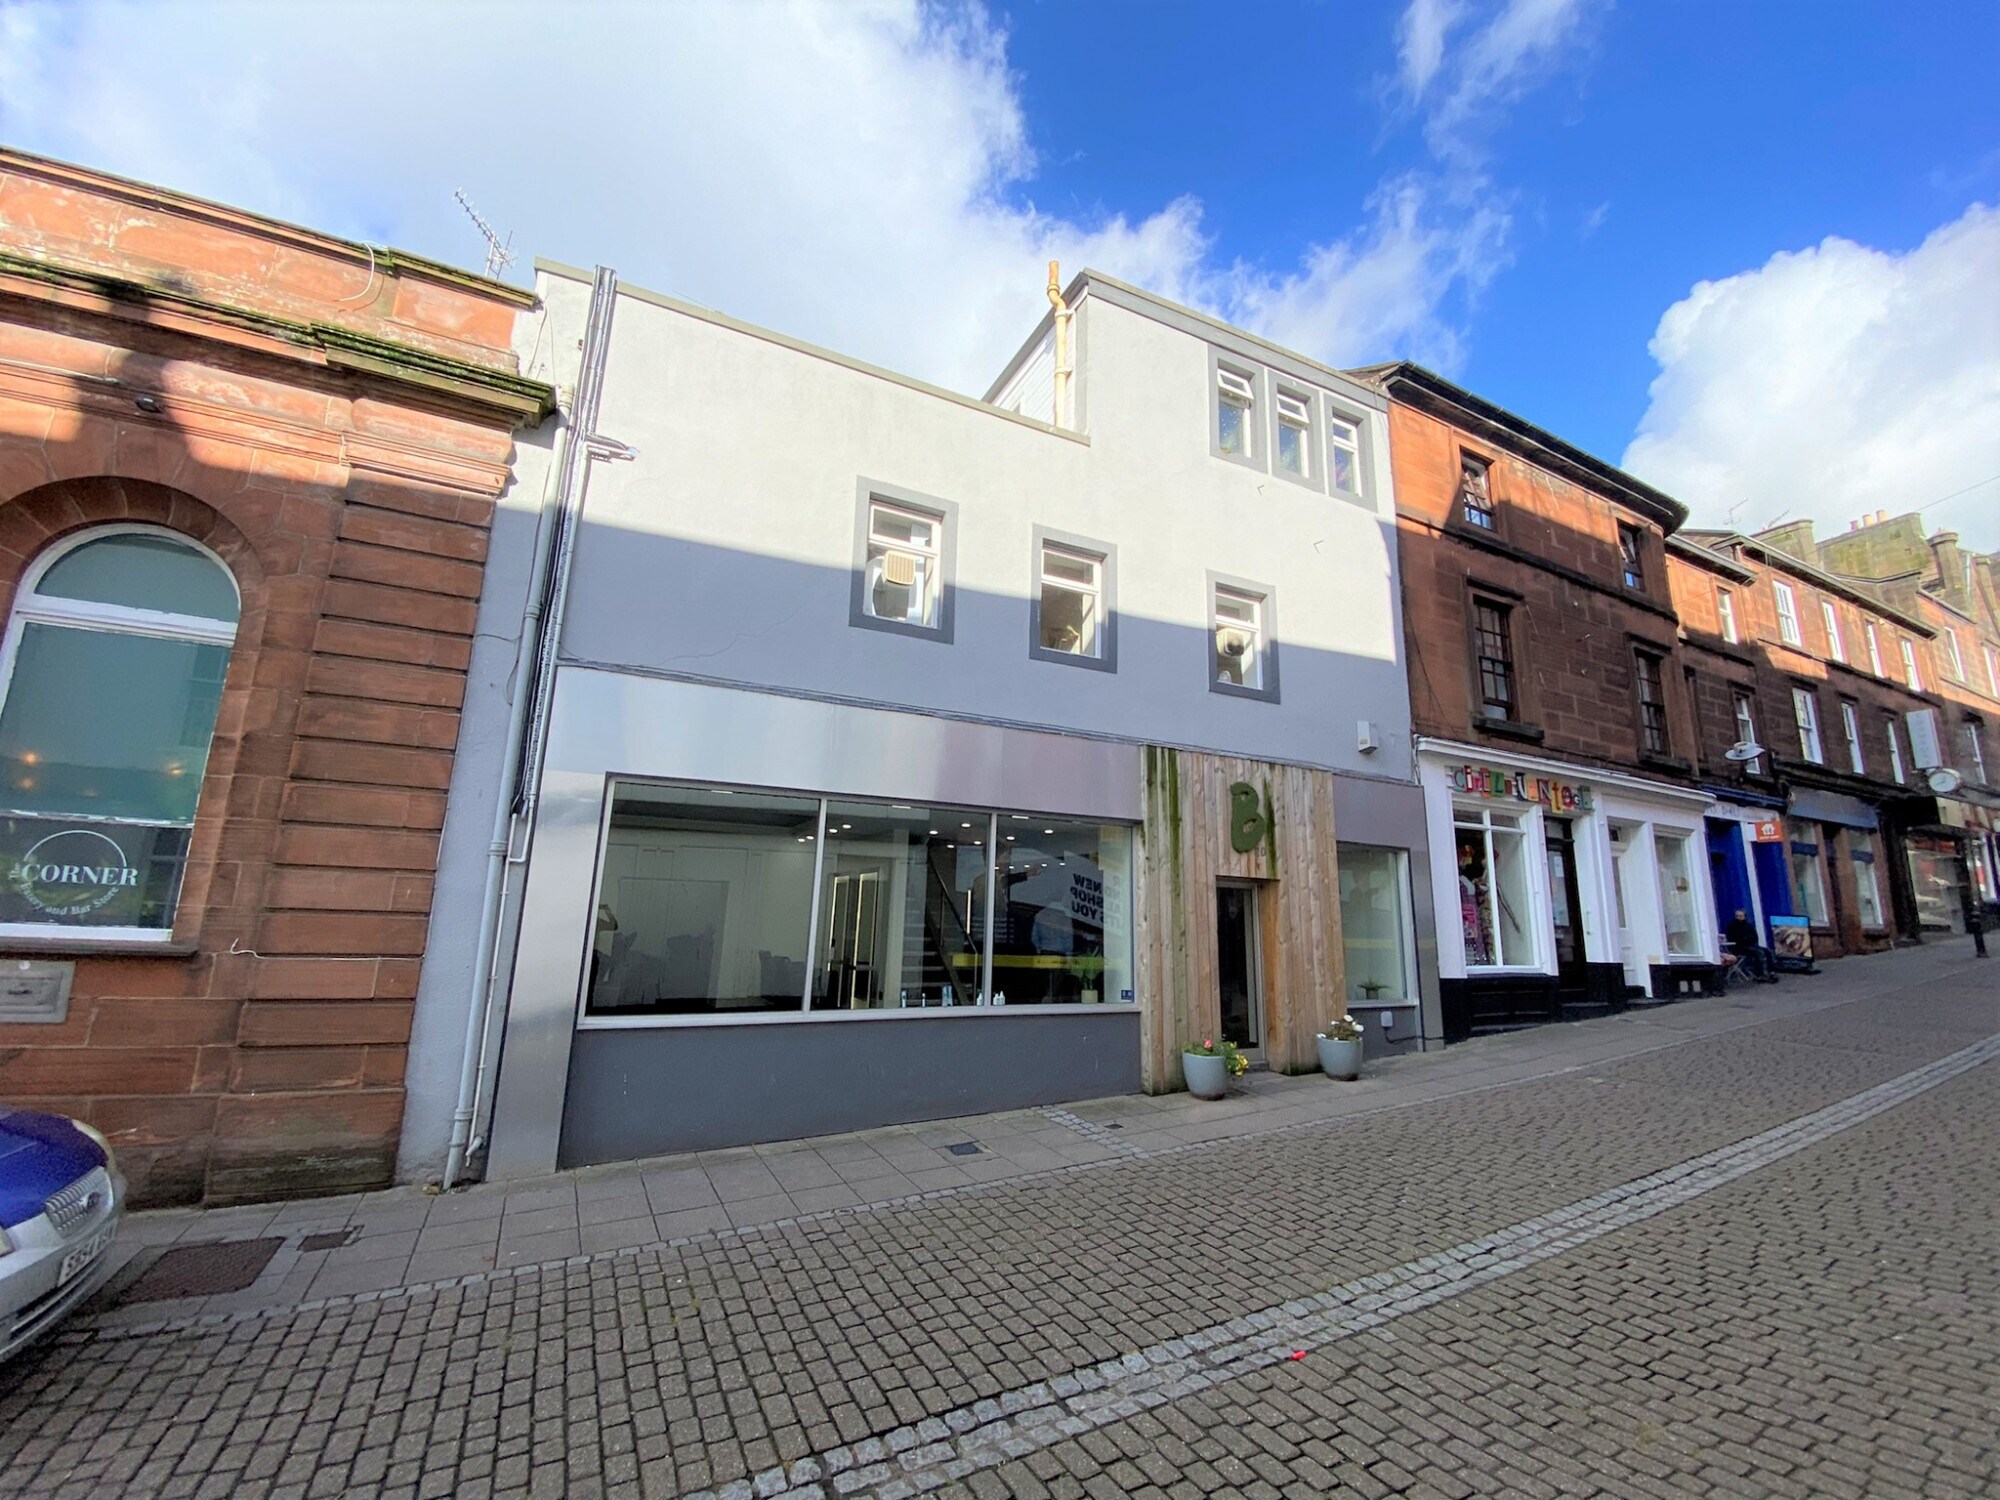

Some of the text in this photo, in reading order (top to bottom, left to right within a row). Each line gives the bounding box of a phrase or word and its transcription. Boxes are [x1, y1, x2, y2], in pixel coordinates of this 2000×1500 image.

[21, 863, 139, 886] CORNER
[45, 906, 68, 915] and
[71, 905, 91, 915] Bar
